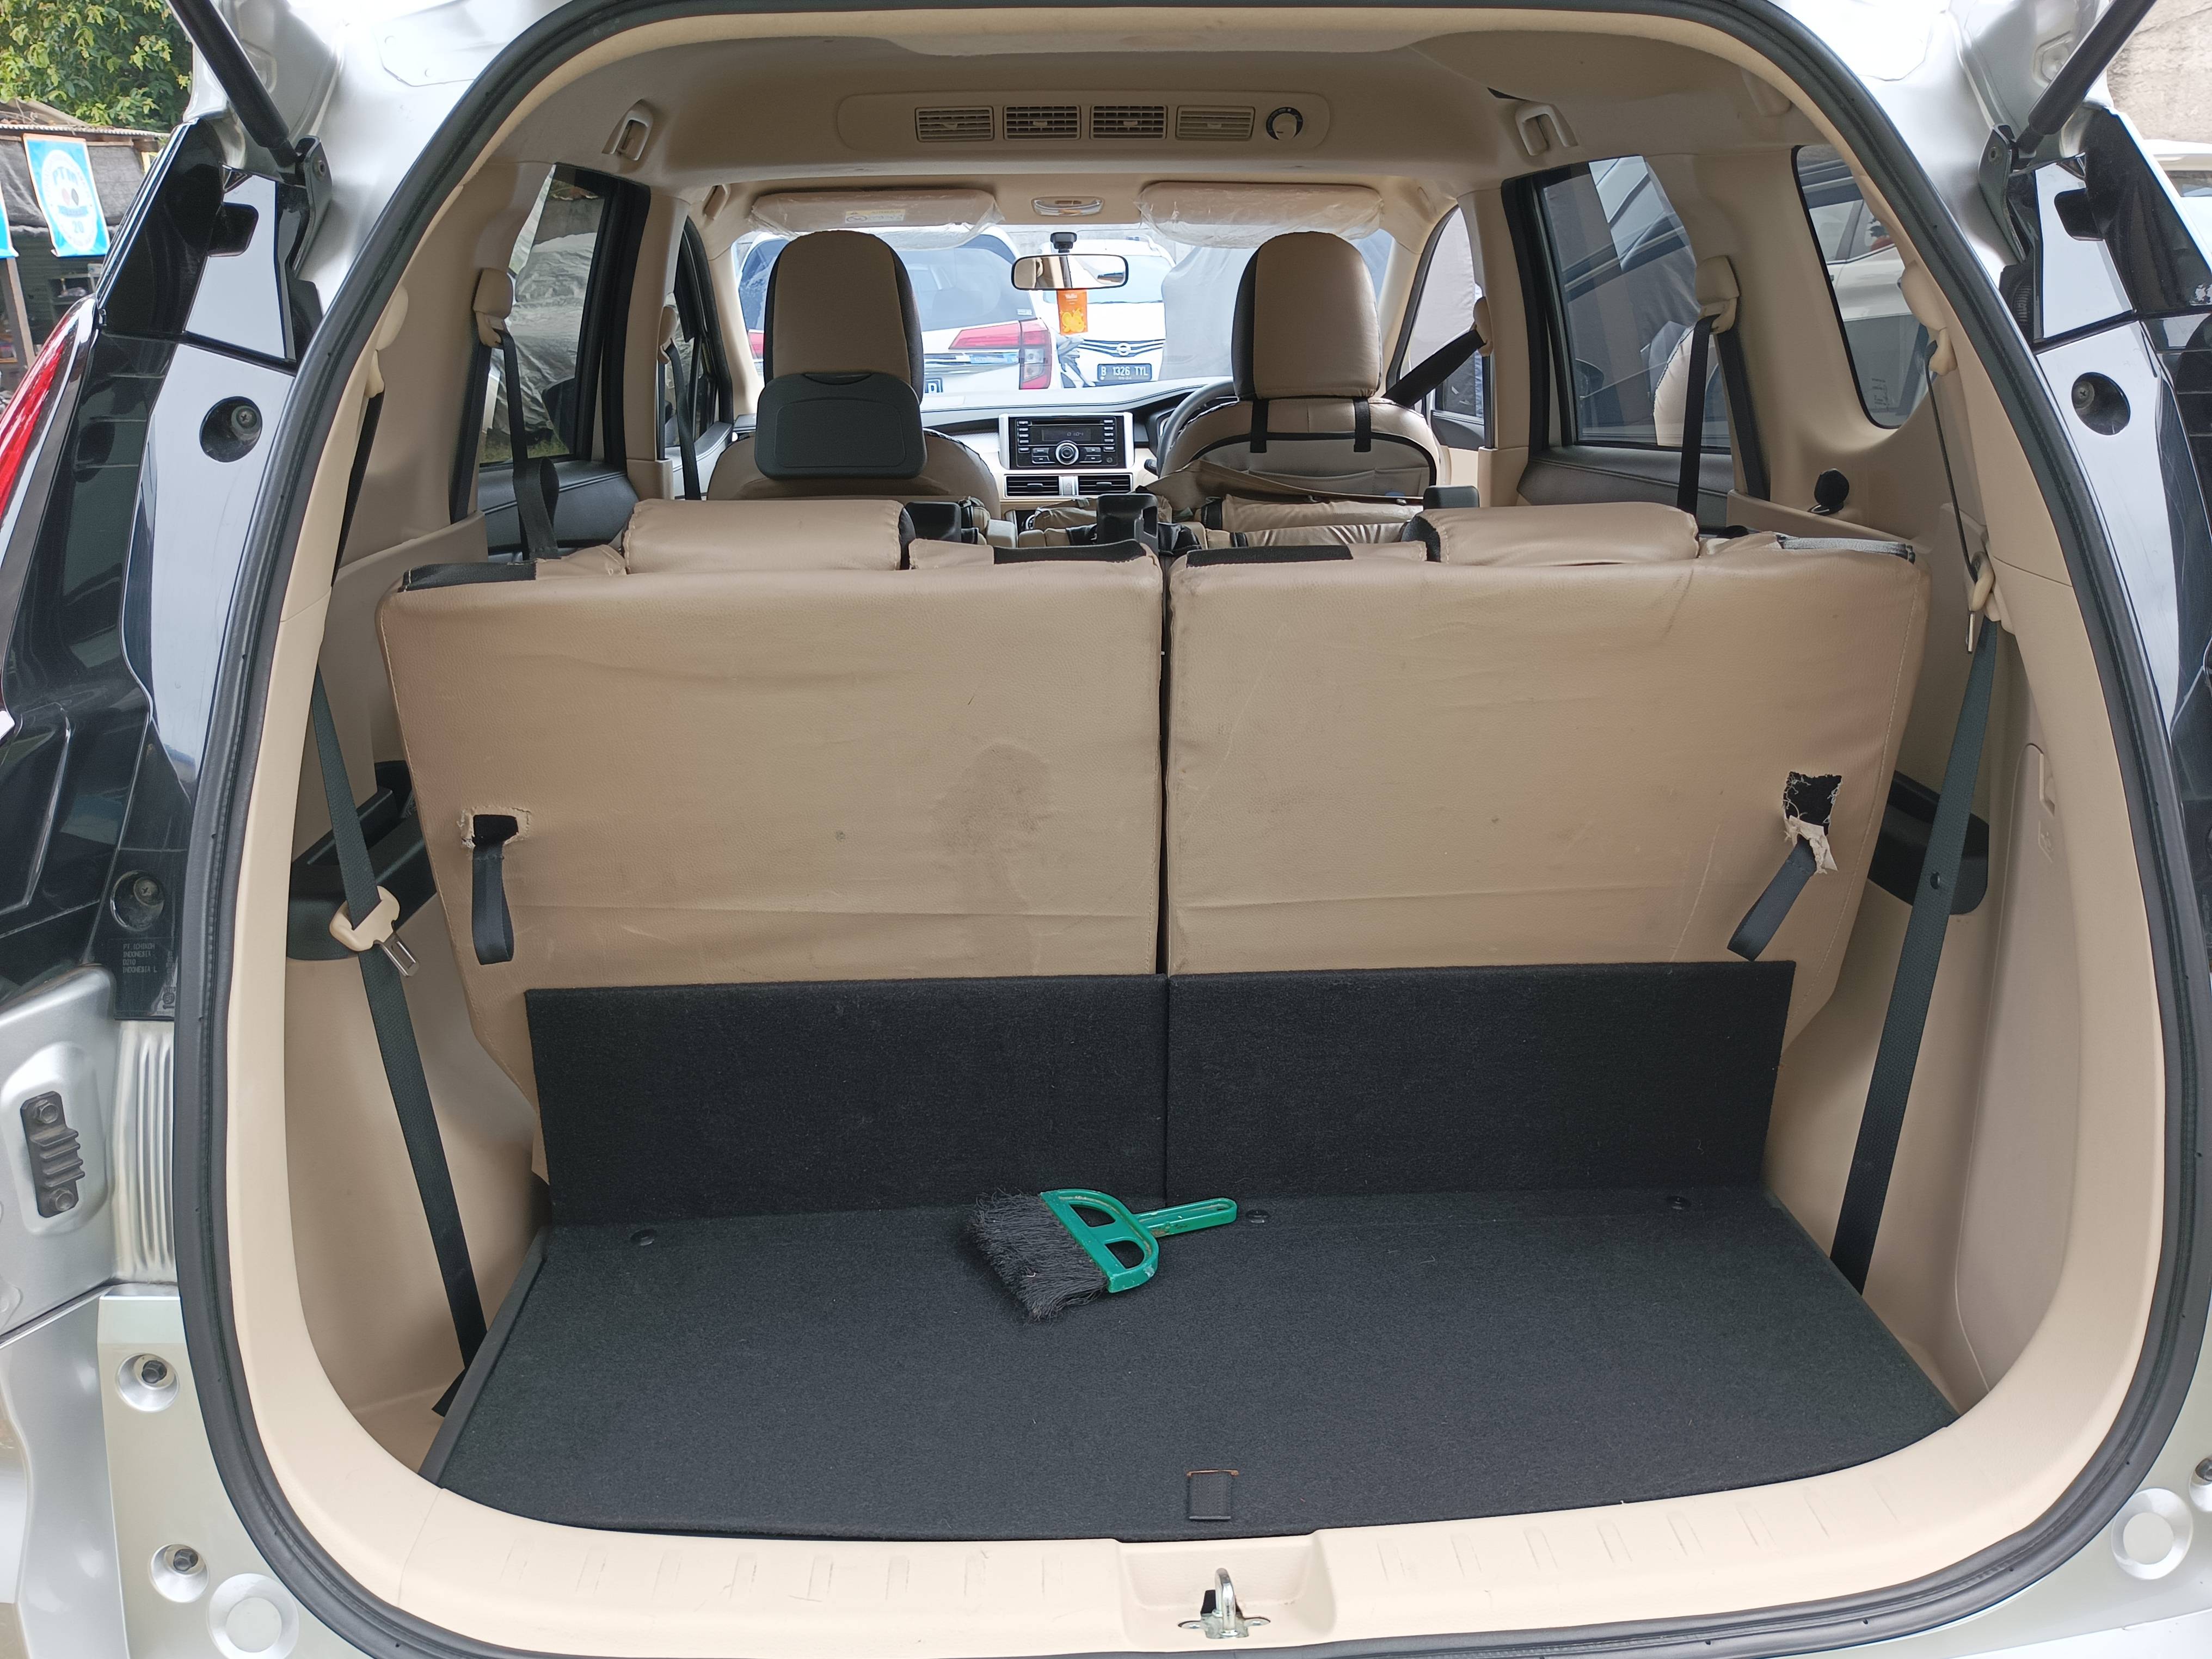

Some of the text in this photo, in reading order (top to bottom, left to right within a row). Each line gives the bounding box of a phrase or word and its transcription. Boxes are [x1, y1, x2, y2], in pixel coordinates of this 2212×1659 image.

[1101, 366, 1148, 376] B 1326 TYL
